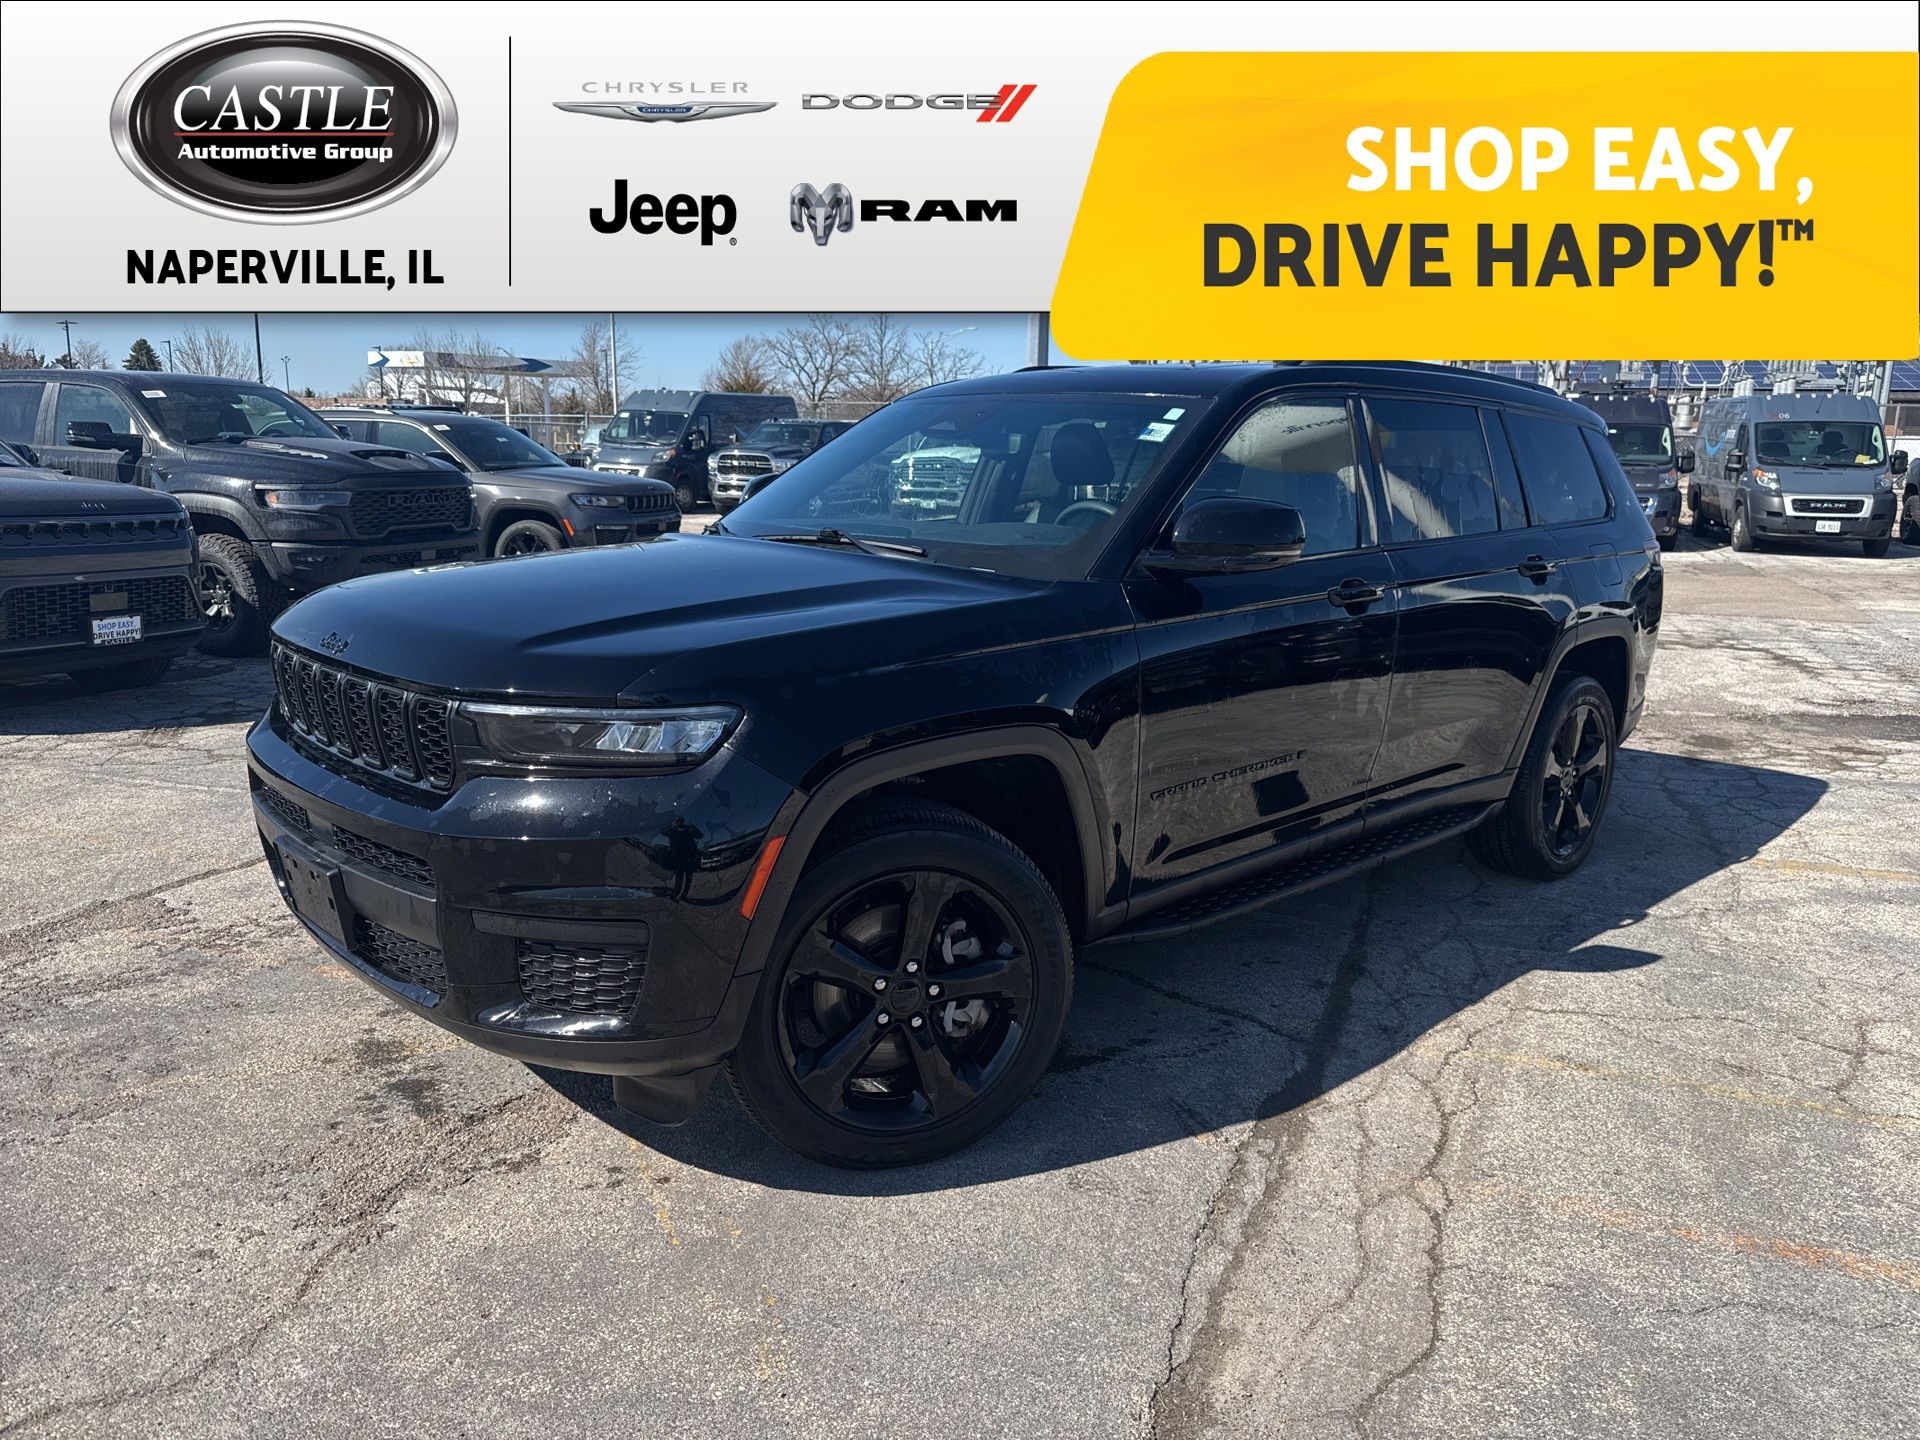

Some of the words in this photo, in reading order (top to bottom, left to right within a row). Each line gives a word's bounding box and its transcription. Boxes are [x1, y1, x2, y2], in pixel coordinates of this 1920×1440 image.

[388, 493, 452, 508] RAM
[97, 623, 116, 631] SHOP
[93, 631, 115, 640] DRIVE
[1150, 776, 1208, 801] GRAND
[1211, 752, 1297, 783] CHEROKEE
